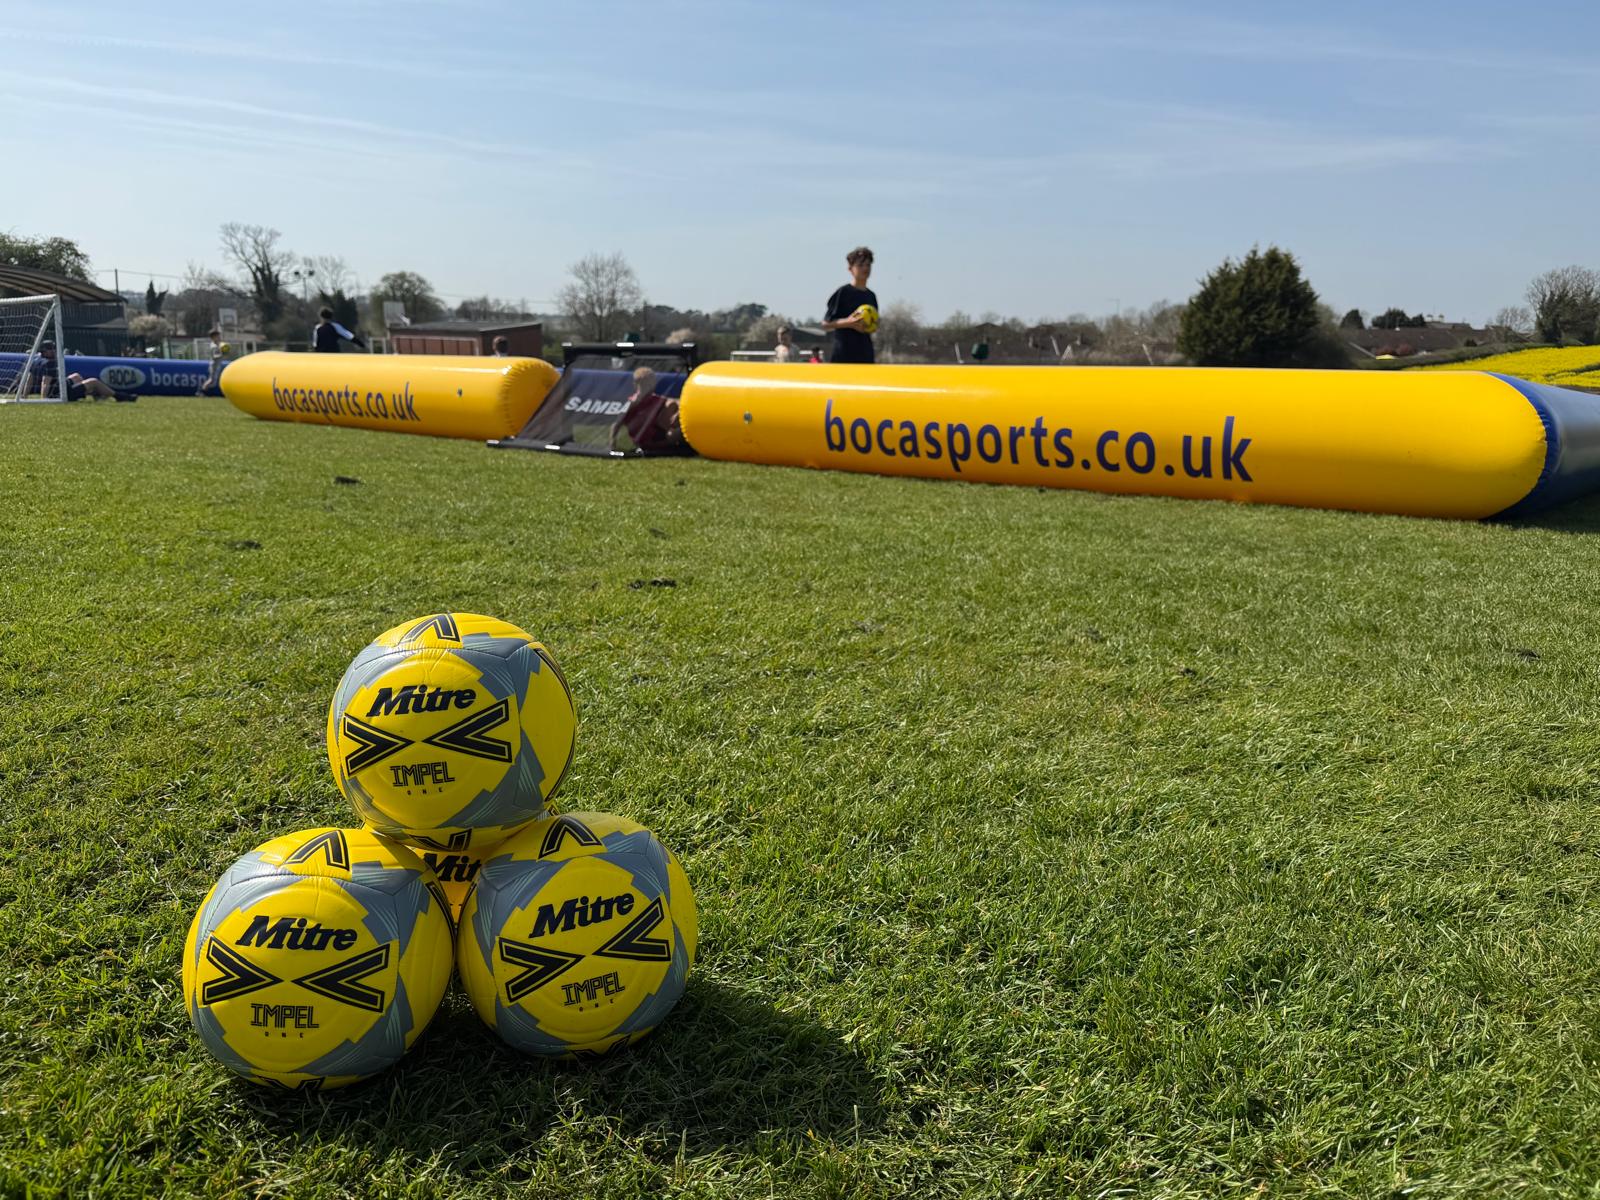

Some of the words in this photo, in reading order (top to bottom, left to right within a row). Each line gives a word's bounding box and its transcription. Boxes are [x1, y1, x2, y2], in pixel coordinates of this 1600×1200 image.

[108, 368, 138, 387] BOCA
[272, 377, 421, 422] bocasports.co.uk
[824, 399, 1253, 482] bocasports.co.uk
[365, 684, 476, 717] Mitre
[389, 761, 456, 787] IMPEL
[407, 787, 443, 796] ONE
[423, 852, 482, 883] Mit
[534, 892, 635, 938] Mitre
[234, 915, 358, 951] Mitre
[561, 971, 625, 1007] IMPEL
[250, 1003, 319, 1029] IMPEL
